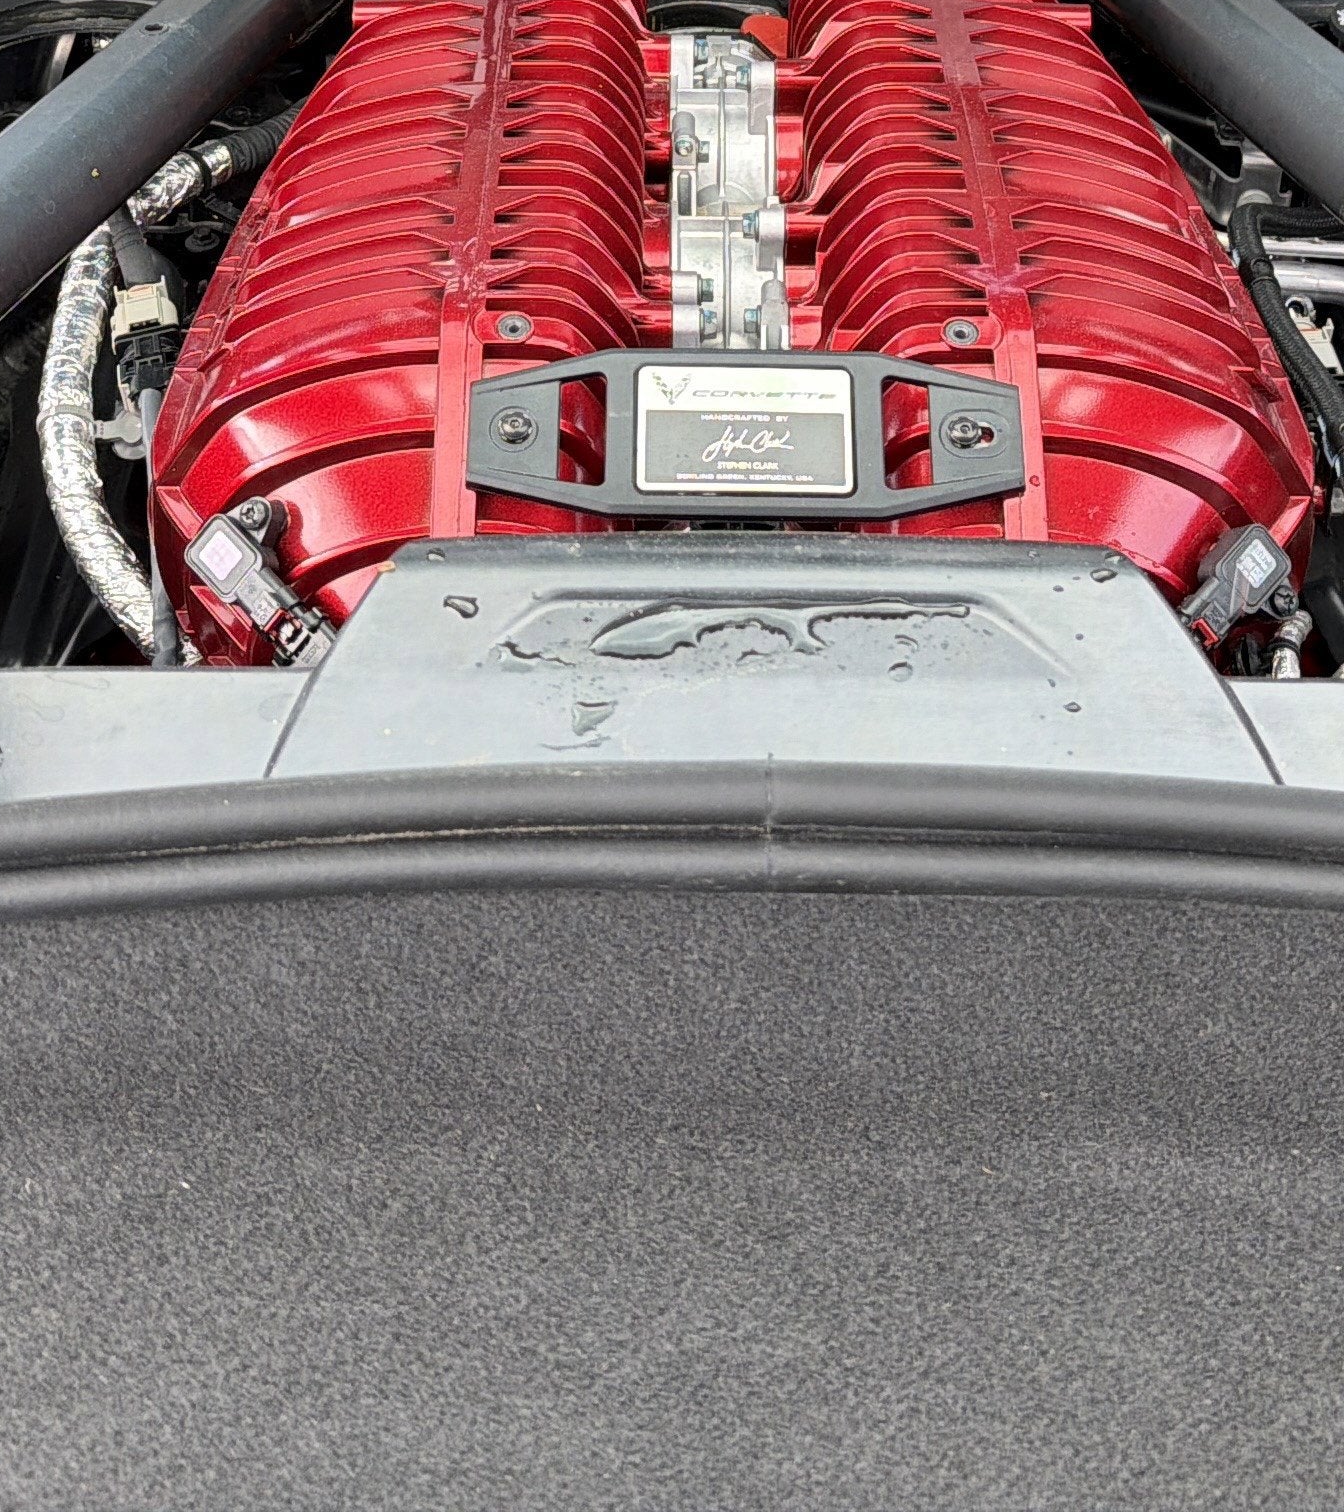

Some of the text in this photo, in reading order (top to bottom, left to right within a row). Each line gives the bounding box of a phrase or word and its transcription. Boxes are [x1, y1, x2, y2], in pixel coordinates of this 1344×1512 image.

[692, 389, 837, 400] CORVETTE
[775, 415, 789, 423] BY
[753, 462, 780, 471] CLARK
